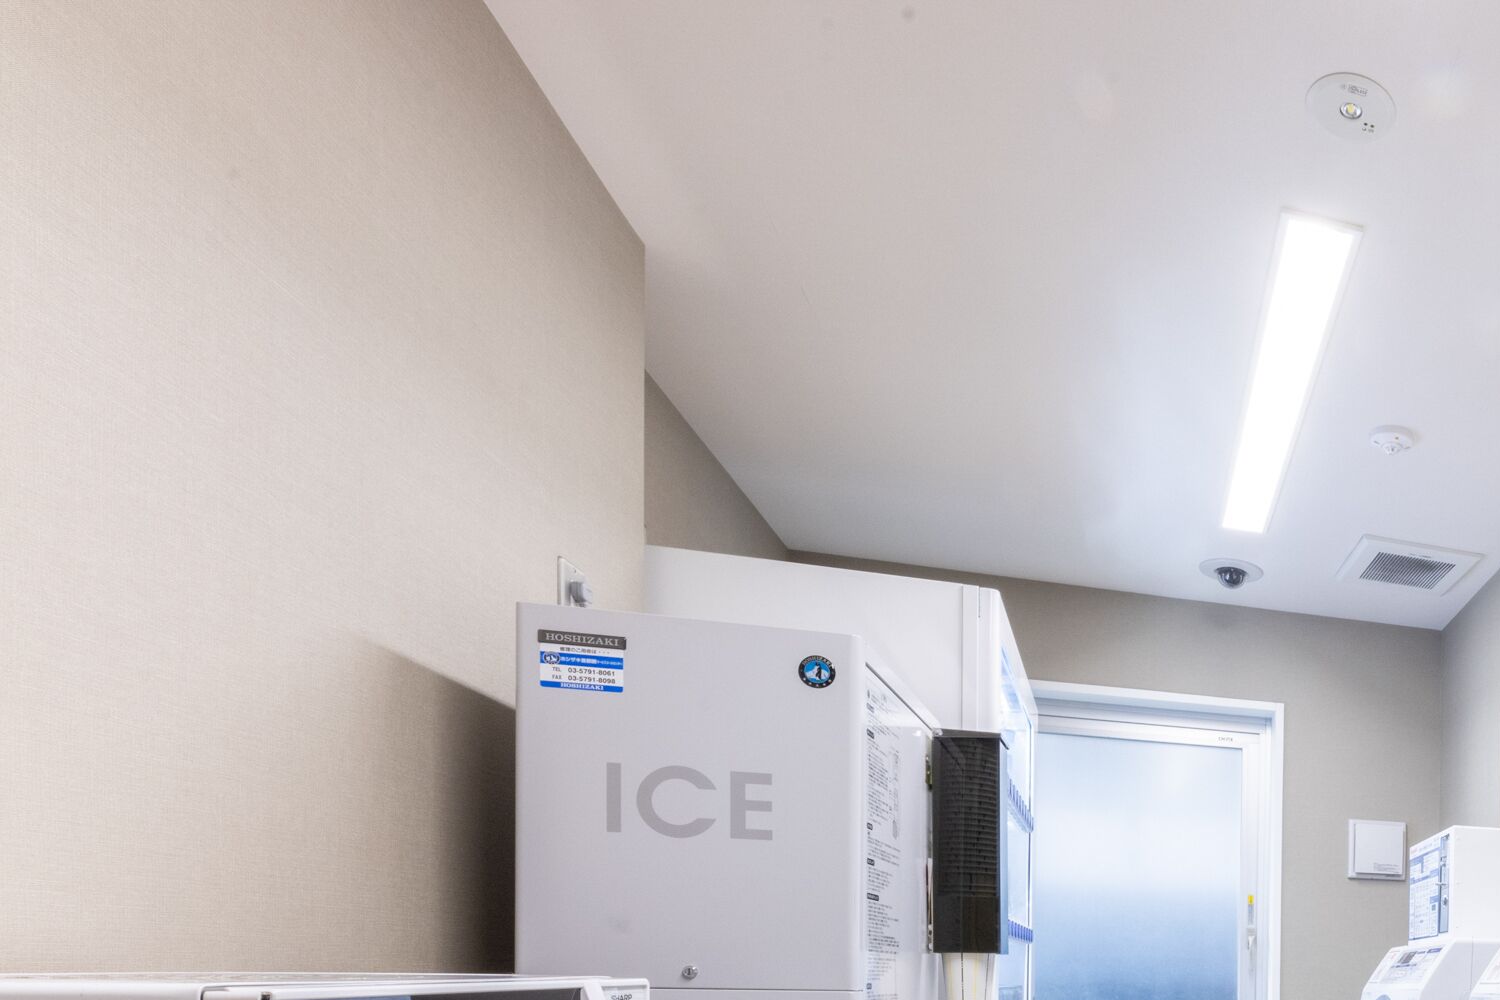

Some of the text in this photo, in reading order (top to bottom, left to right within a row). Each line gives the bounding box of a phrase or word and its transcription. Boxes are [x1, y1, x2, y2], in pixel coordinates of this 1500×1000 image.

[545, 632, 620, 647] HOSHIZAKI
[568, 667, 616, 676] 03-5791-8061
[568, 675, 616, 684] 03-5791-8098
[560, 682, 605, 691] HOSHIZAKI
[606, 762, 773, 841] ICE
